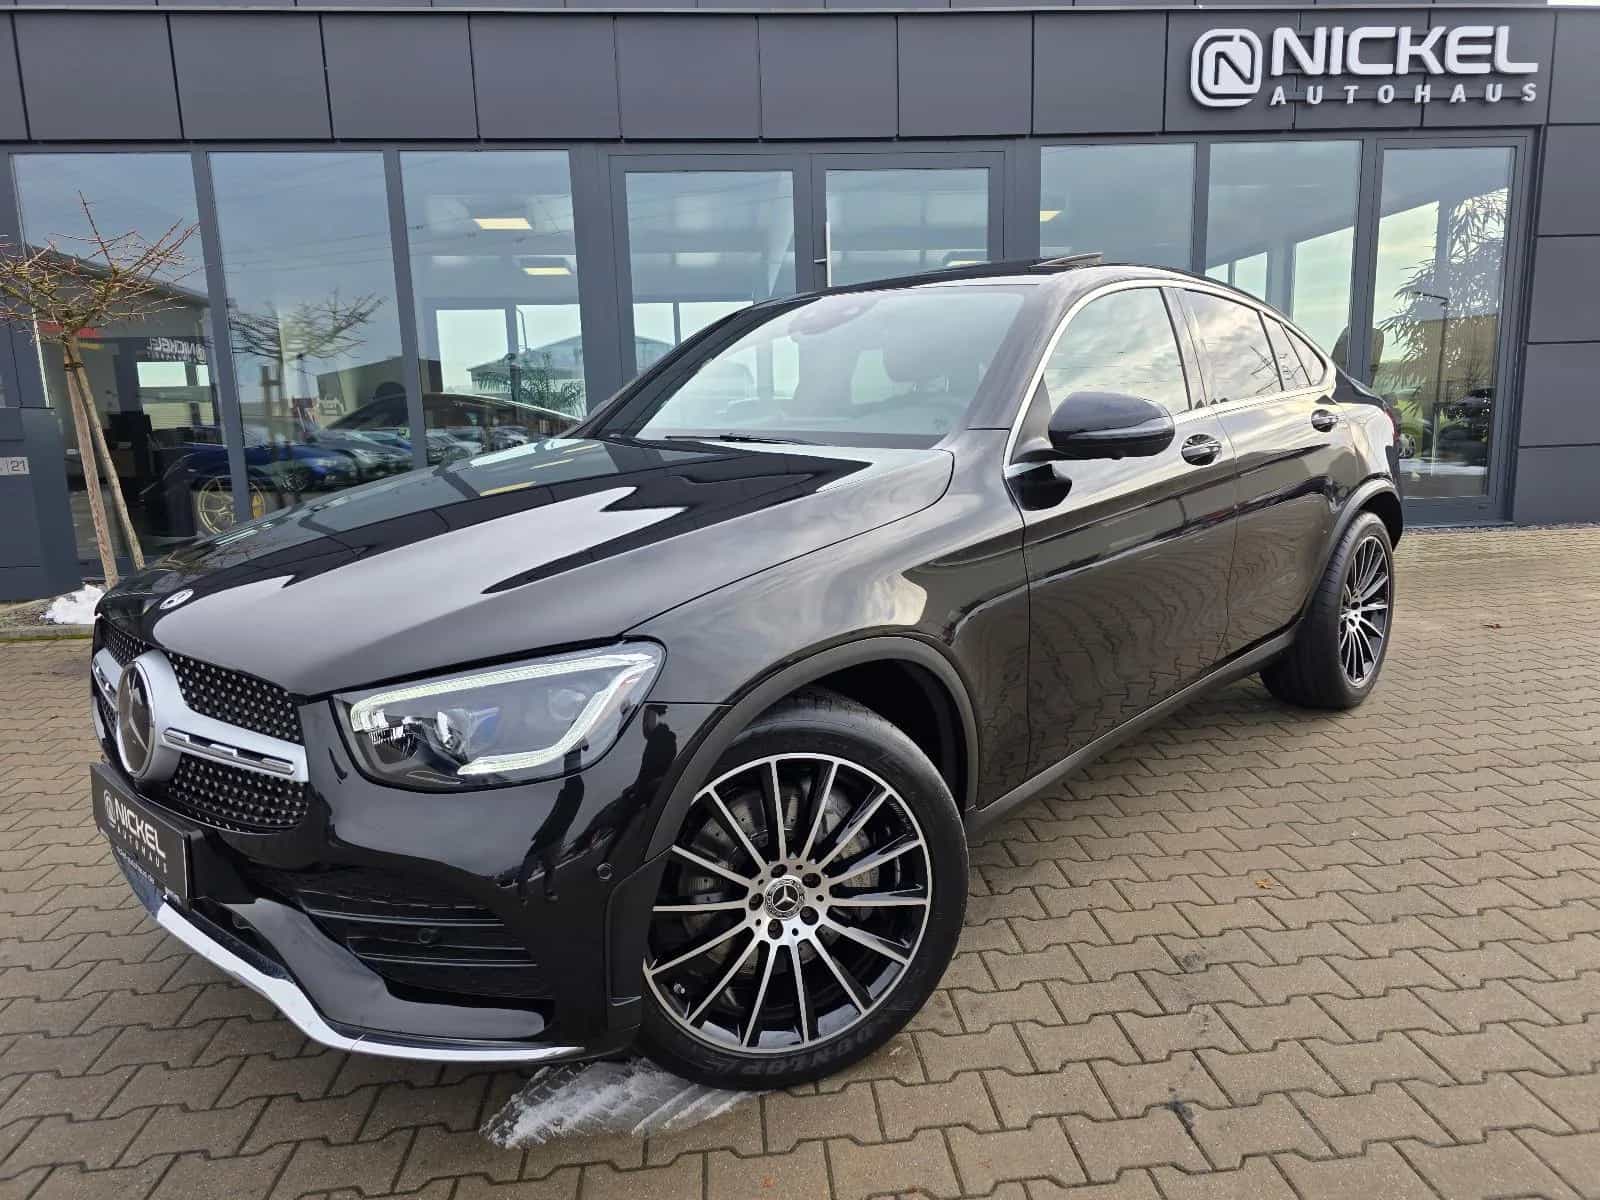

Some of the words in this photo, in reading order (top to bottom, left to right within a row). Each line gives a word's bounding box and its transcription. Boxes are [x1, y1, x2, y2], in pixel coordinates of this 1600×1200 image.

[1270, 26, 1540, 76] NICKEL
[1269, 83, 1537, 106] AUTOHAUS
[114, 797, 166, 858] NICKEL
